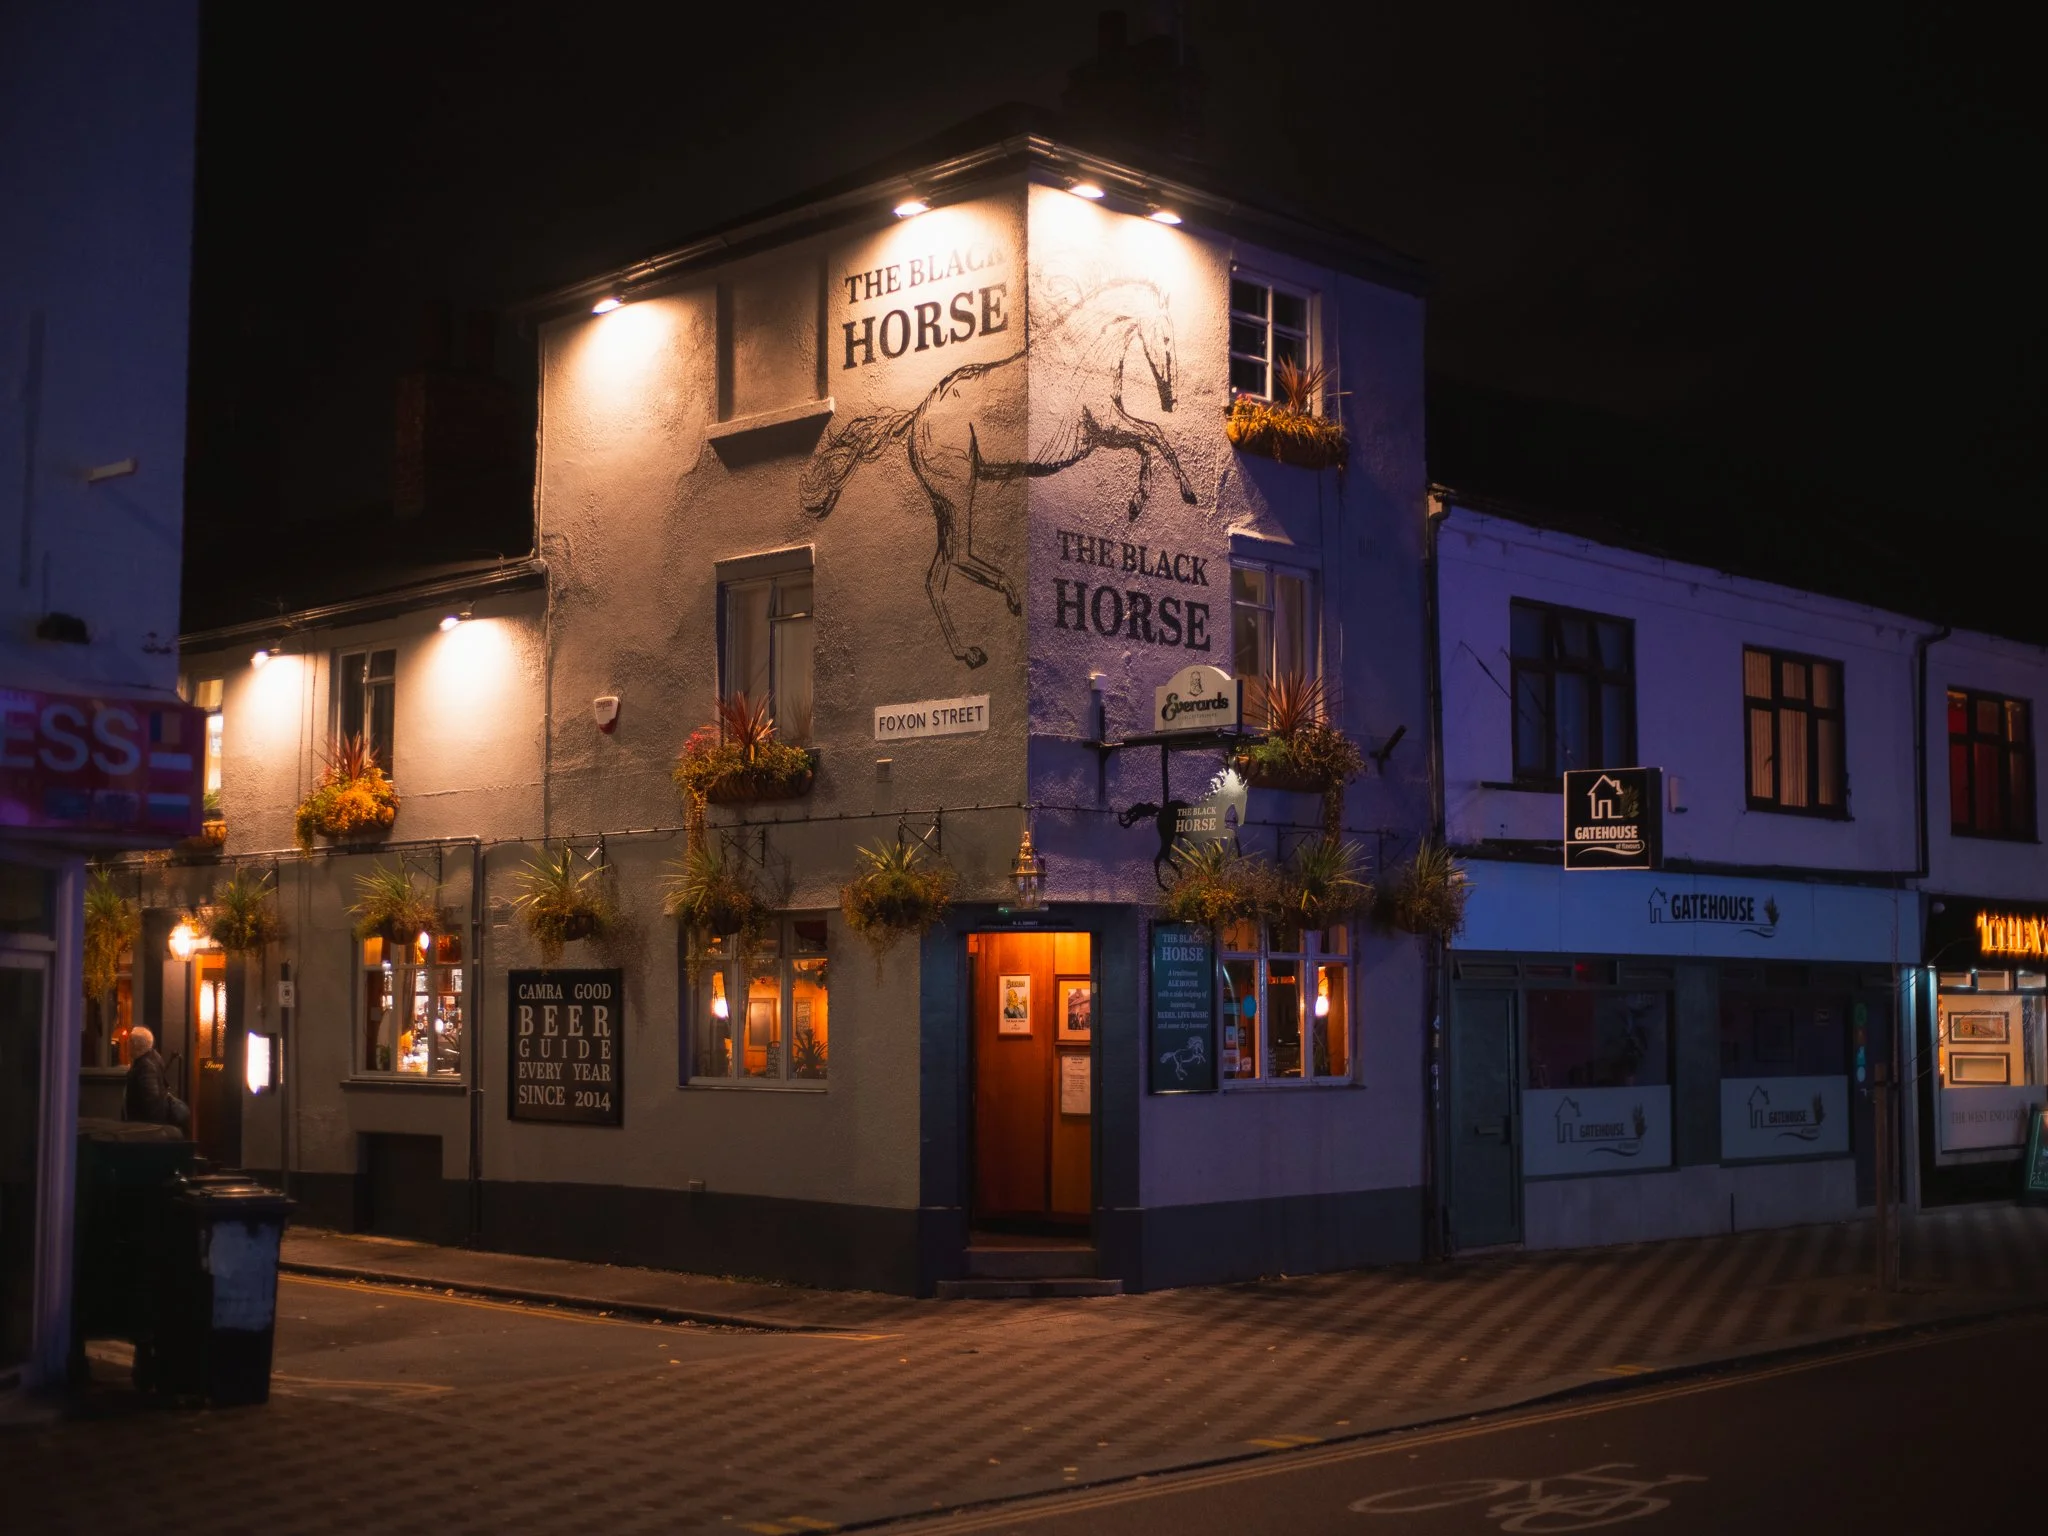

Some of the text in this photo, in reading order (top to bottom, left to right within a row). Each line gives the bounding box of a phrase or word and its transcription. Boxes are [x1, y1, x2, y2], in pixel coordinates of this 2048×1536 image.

[844, 242, 1007, 304] THE BLACK
[842, 282, 1009, 371] HORSE
[1057, 529, 1209, 586] THE BLACK
[1053, 577, 1211, 653] HORSE
[1161, 691, 1229, 721] Everards
[879, 705, 984, 732] FOXON STREET
[1177, 806, 1217, 817] THE BLACK
[1175, 817, 1217, 833] HORSE
[1574, 825, 1638, 840] GATEHOUSE
[1671, 893, 1755, 922] GATEHOUSE
[1162, 933, 1204, 944] THE BLACK
[1161, 946, 1204, 962] HORSE
[518, 983, 612, 1000] CAMRA GOOD
[518, 1004, 611, 1037] BEER
[519, 1038, 611, 1060] GUIDE
[518, 1062, 611, 1082] EVERY YEAR
[518, 1085, 611, 1111] SINCE 2014
[1579, 1122, 1626, 1138] GATEHOUSE
